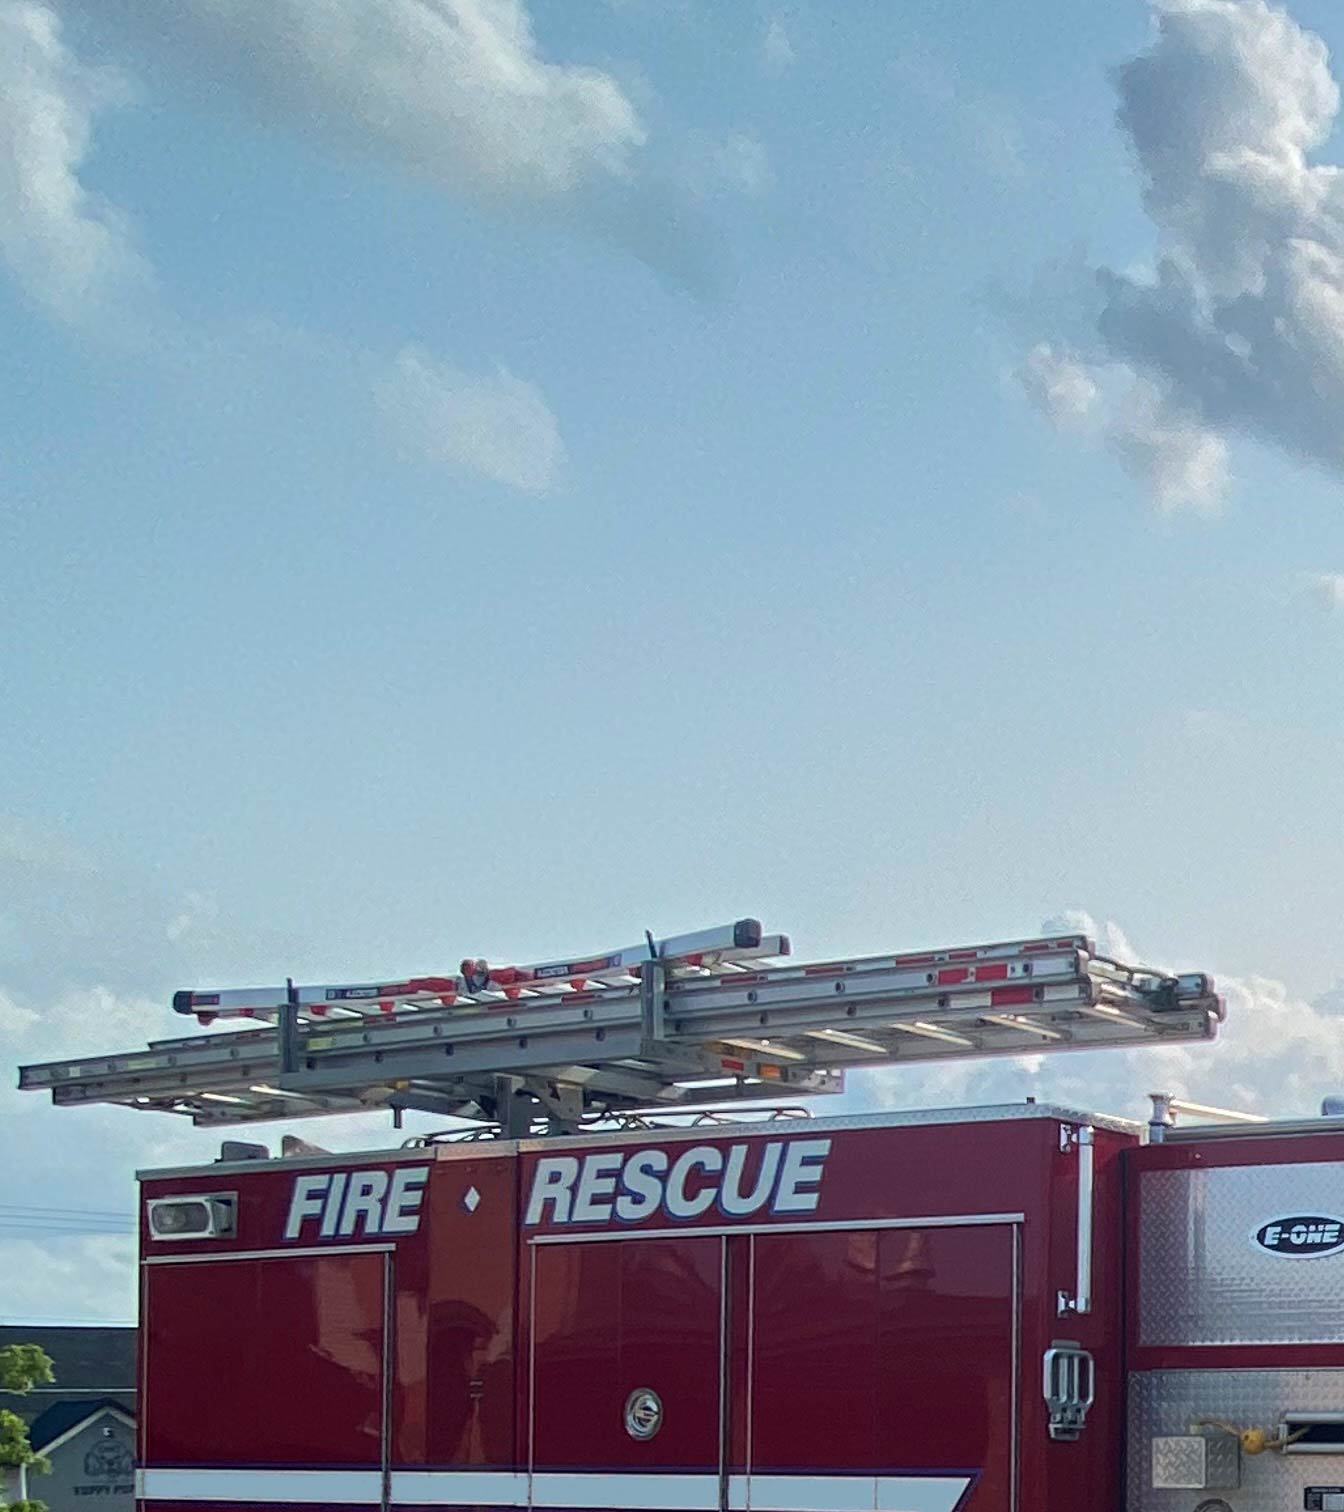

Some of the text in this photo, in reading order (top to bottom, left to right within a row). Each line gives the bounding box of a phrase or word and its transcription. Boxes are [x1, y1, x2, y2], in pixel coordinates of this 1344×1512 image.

[284, 1138, 832, 1239] FIRE RESCUE
[1263, 1223, 1341, 1246] E-ONE
